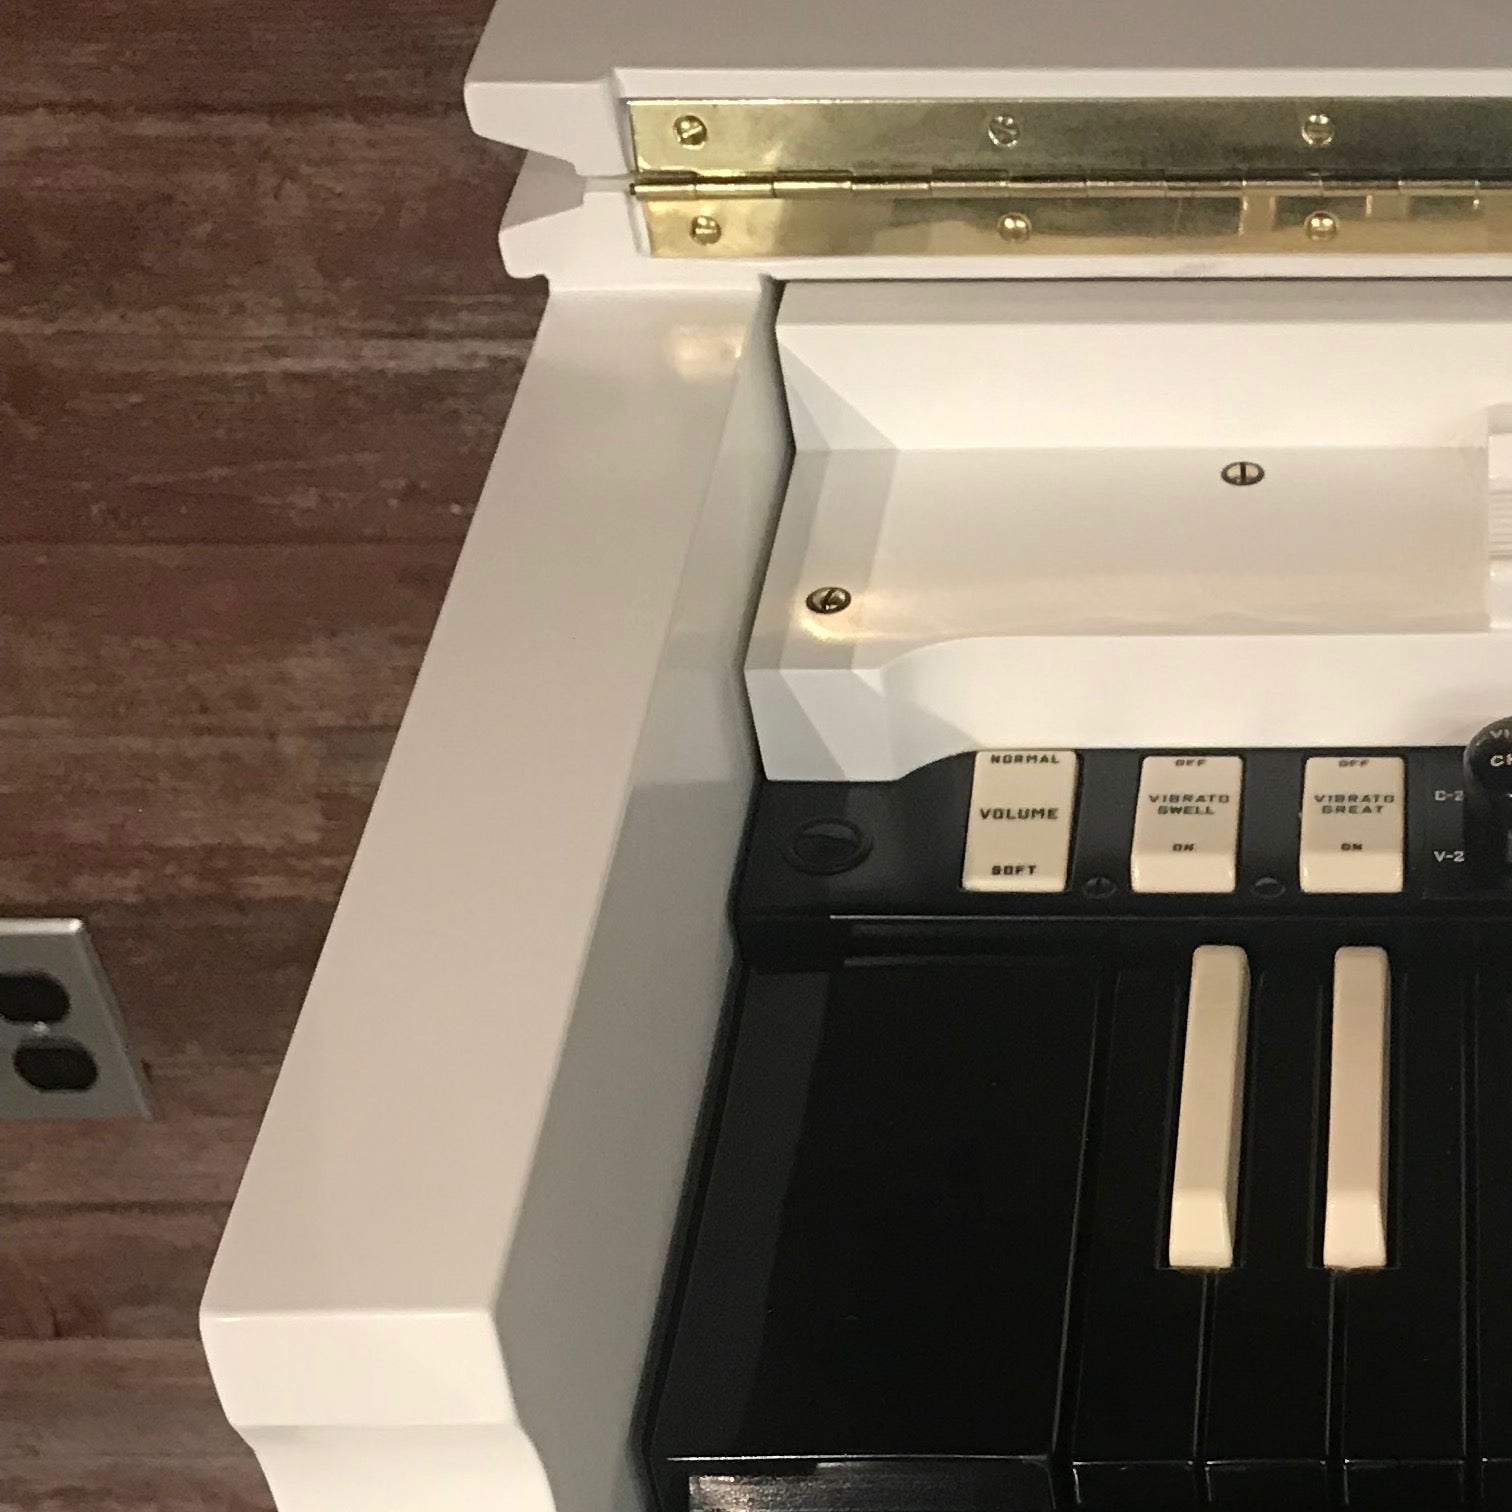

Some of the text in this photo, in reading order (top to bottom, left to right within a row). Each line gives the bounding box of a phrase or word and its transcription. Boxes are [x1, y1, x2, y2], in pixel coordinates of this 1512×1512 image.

[990, 754, 1060, 764] NORMAL
[1174, 759, 1206, 767] OFF
[1338, 759, 1368, 768] OFF
[1148, 794, 1230, 803] VIBRATO
[1313, 794, 1395, 803] VIBRATO
[1434, 790, 1464, 802] C-2
[979, 807, 1058, 820] VOLUME
[1157, 805, 1215, 815] SWELL
[1321, 805, 1384, 815] GREAT
[1172, 843, 1195, 852] ON
[1340, 842, 1363, 852] ON
[1433, 851, 1465, 863] V-2
[991, 864, 1037, 876] SOFT
